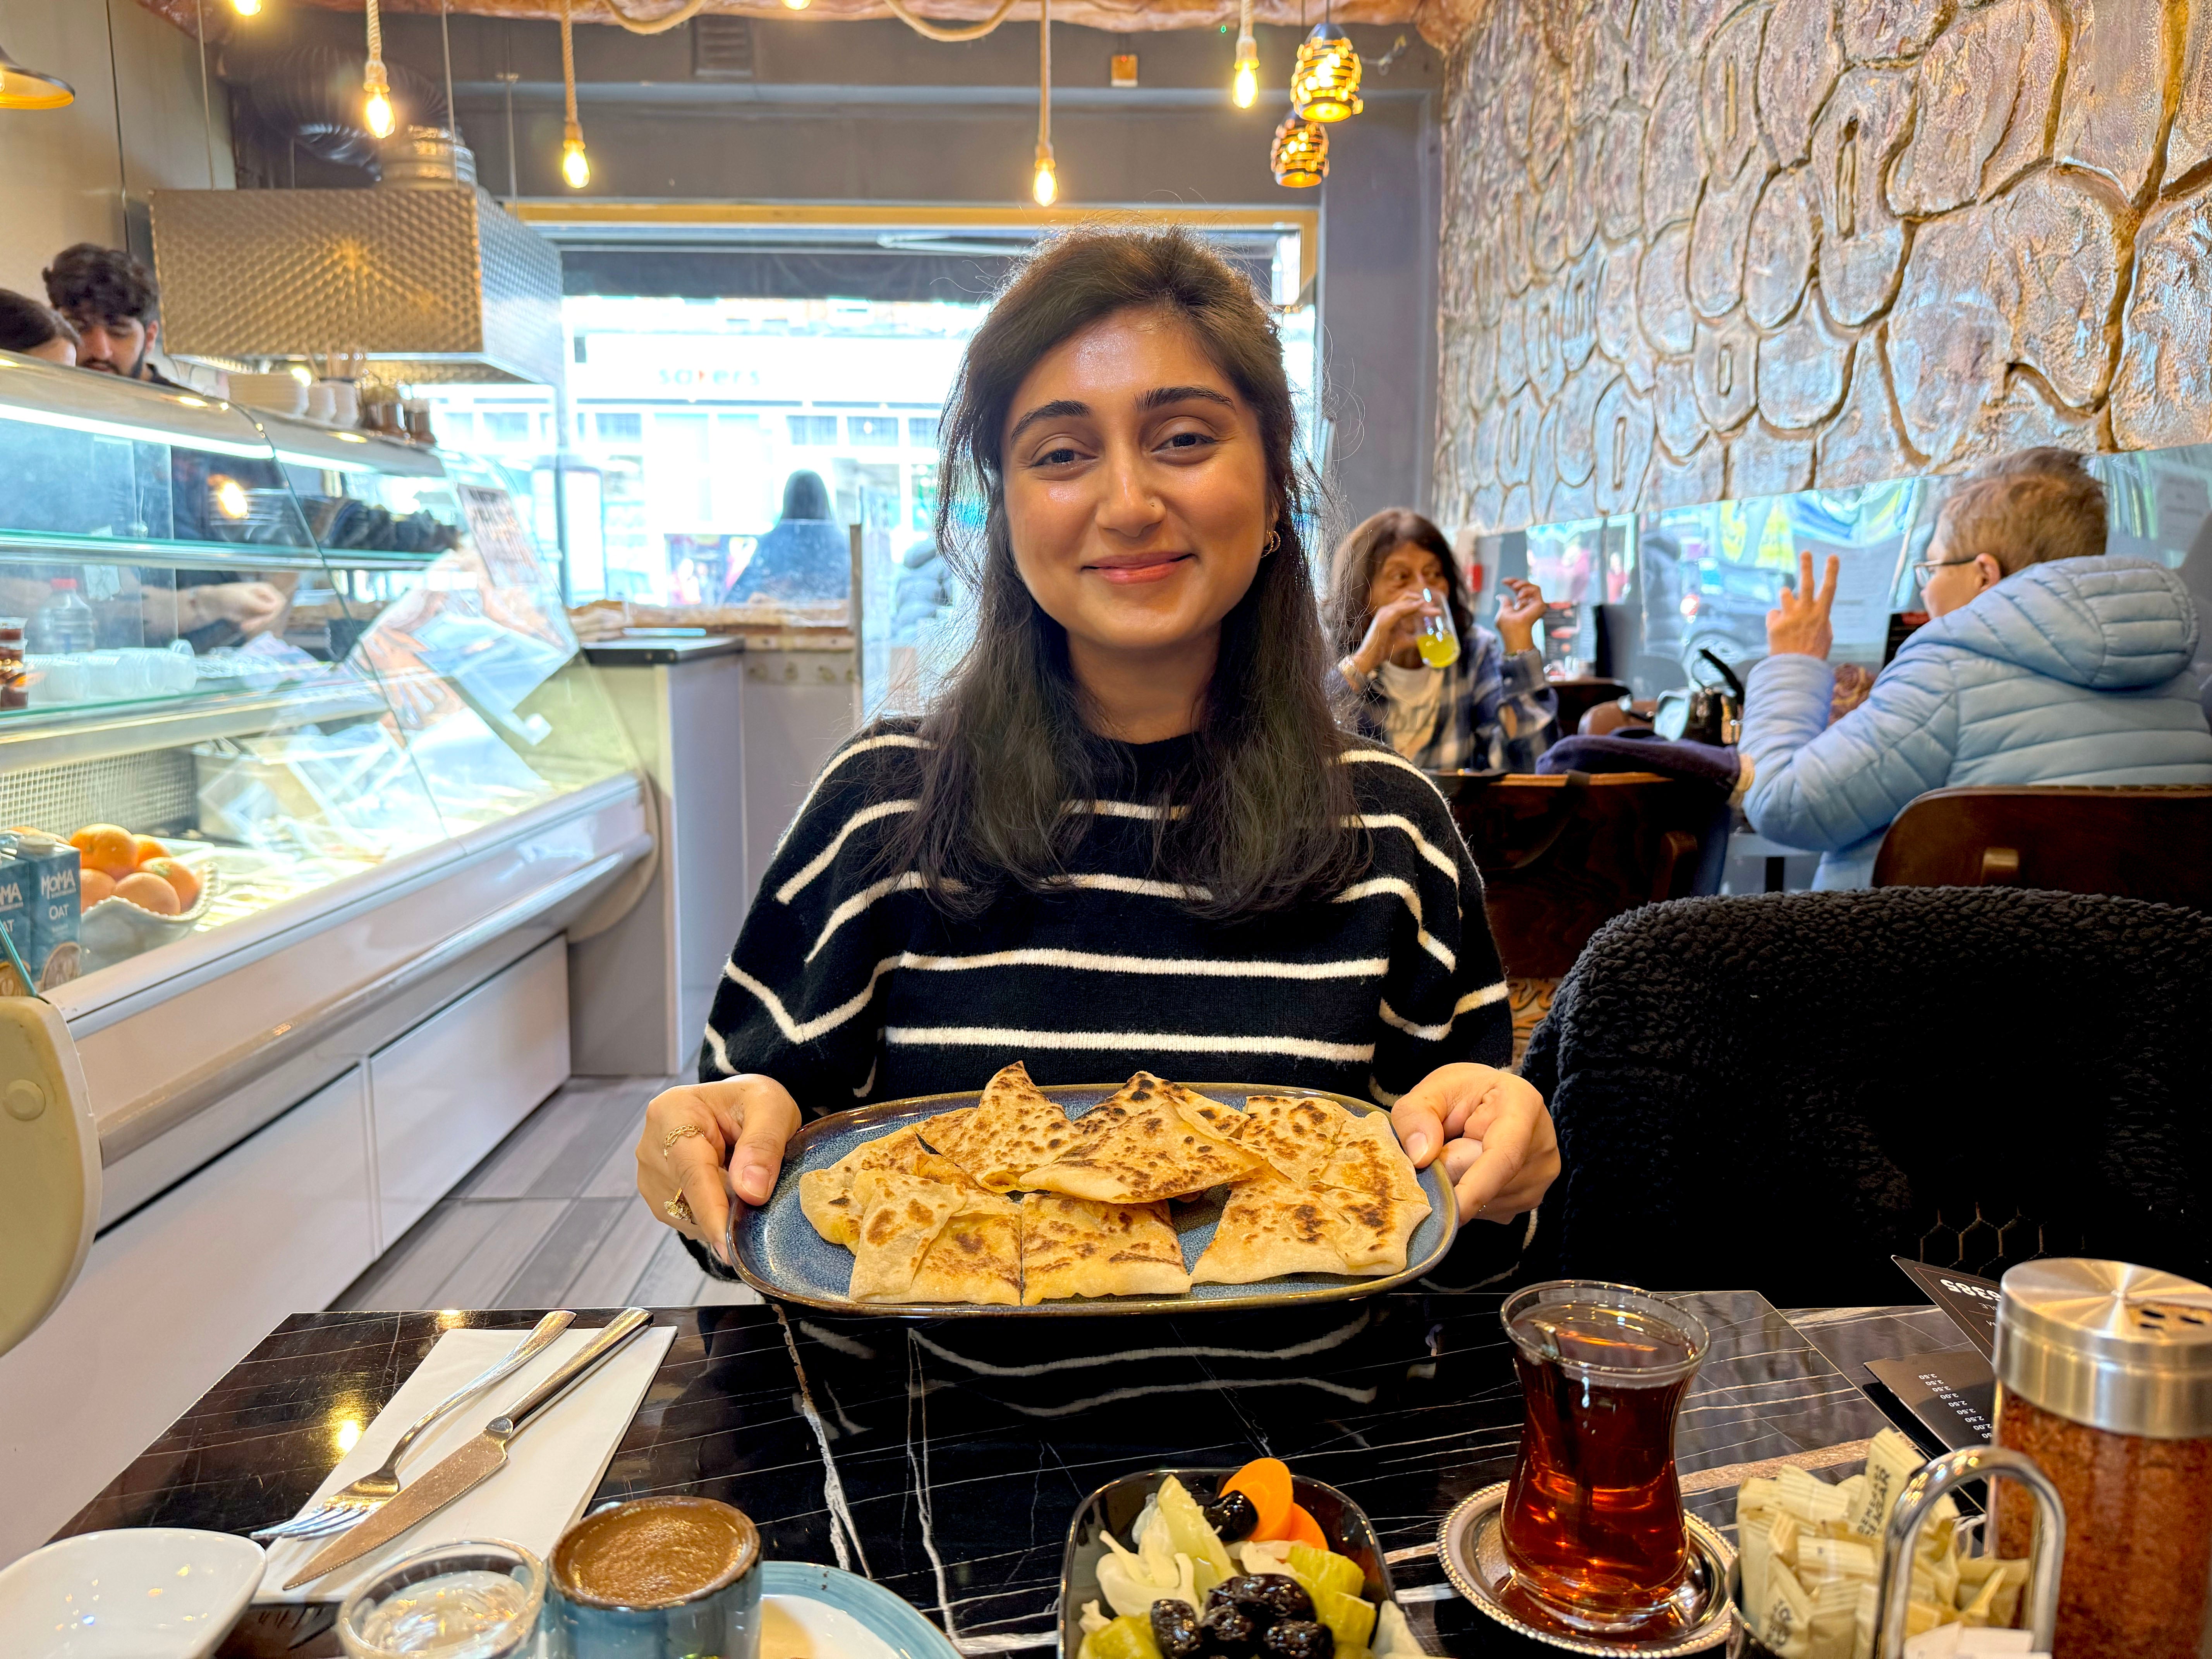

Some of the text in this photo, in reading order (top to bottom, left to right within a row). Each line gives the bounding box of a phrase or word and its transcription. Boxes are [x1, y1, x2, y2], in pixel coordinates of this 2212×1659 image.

[0, 882, 22, 905] MA
[41, 869, 76, 900] MOMA
[49, 903, 69, 920] OAT
[3, 919, 14, 933] AT
